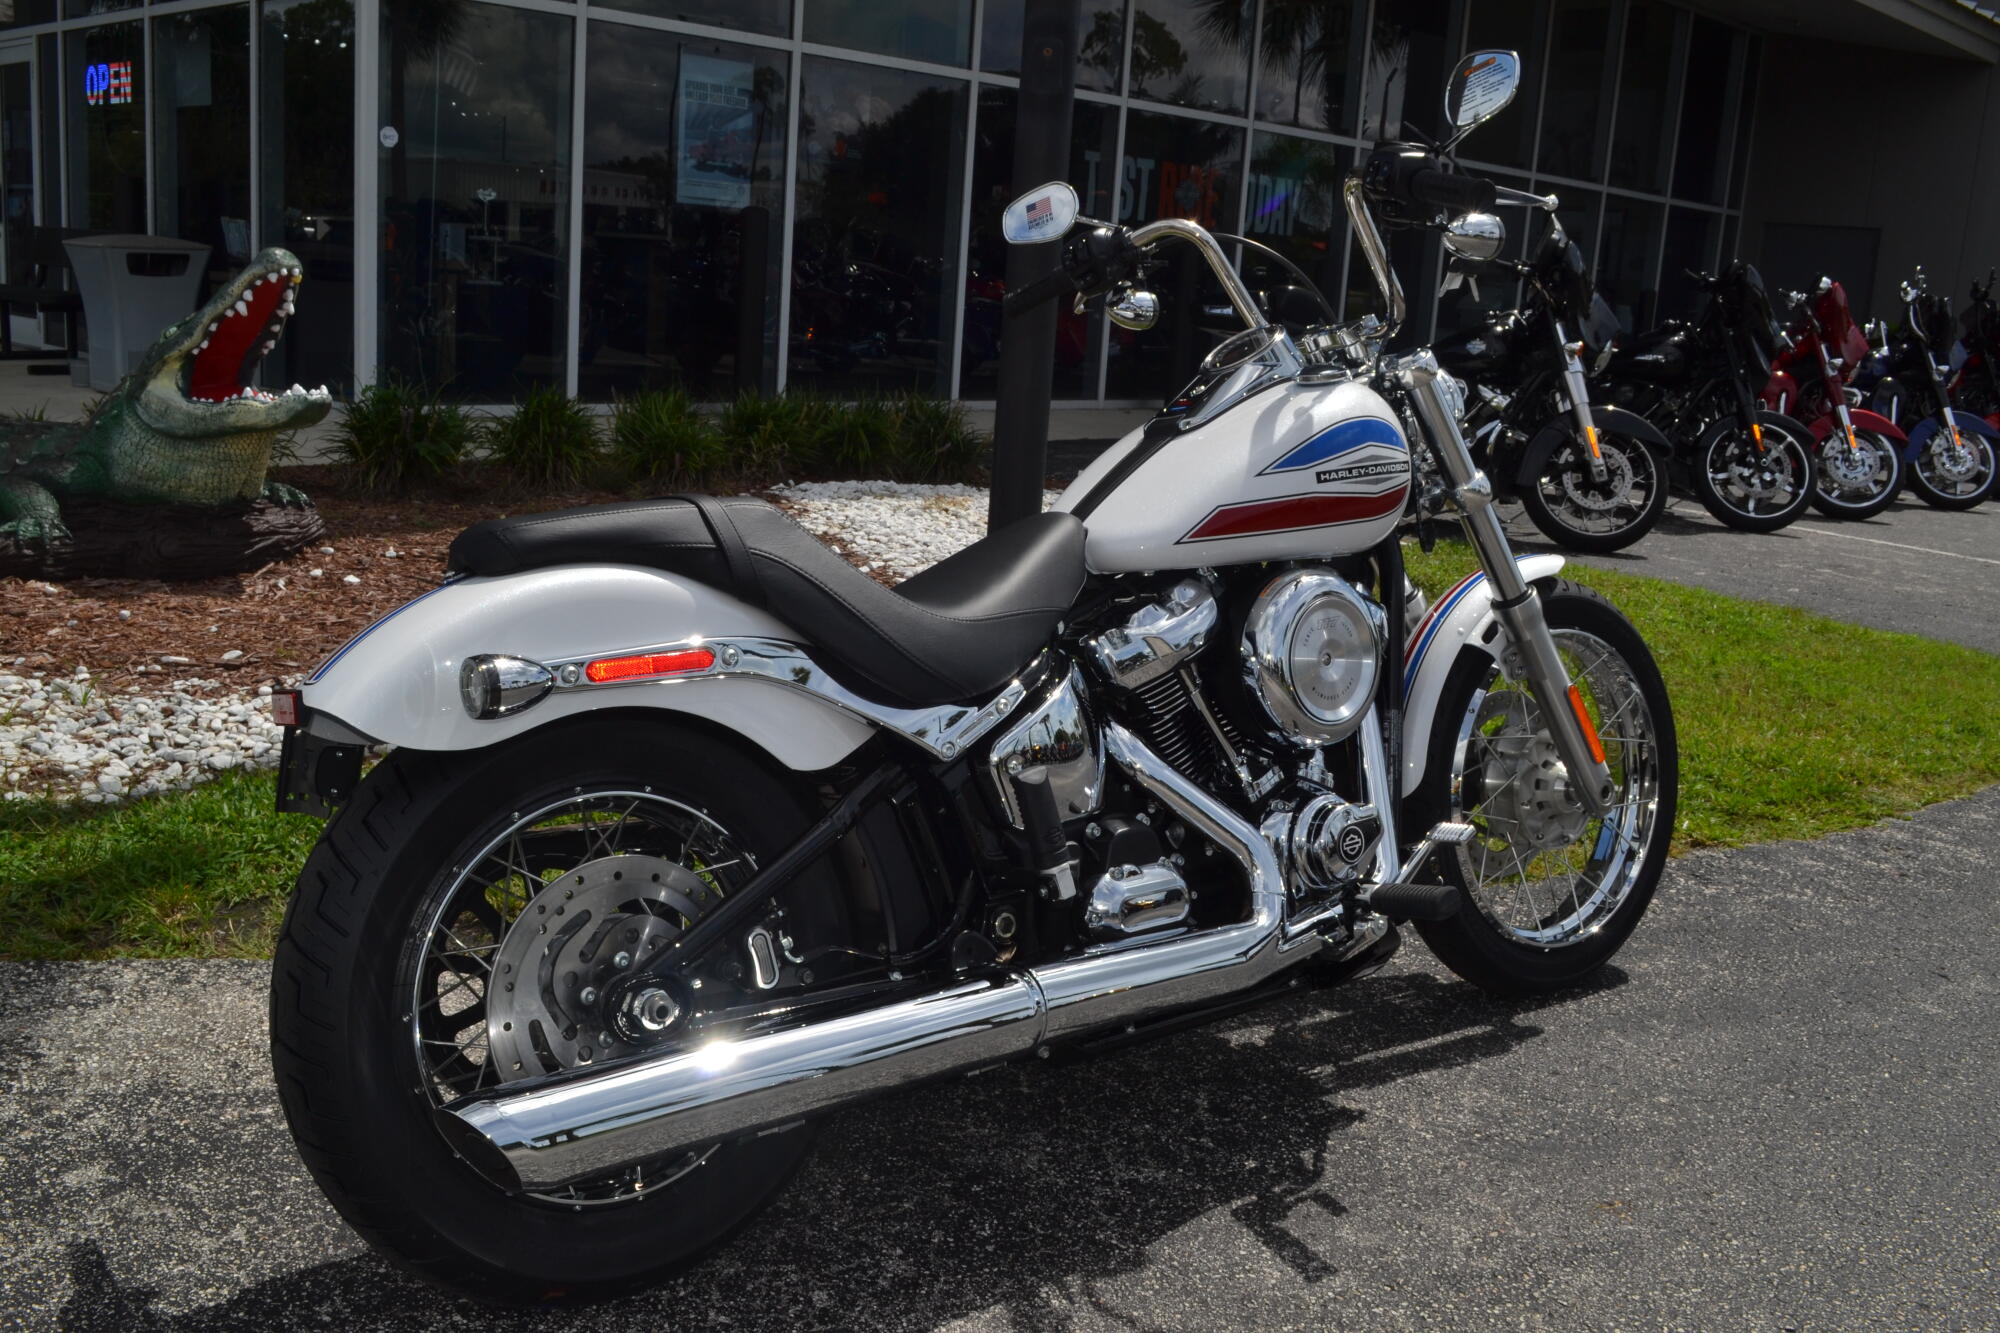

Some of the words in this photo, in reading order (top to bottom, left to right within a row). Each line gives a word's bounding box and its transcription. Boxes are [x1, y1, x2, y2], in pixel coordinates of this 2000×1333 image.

[86, 61, 132, 106] OPEN
[1084, 150, 1156, 222] TST
[1320, 464, 1408, 481] HARLEY-DAVIDSON
